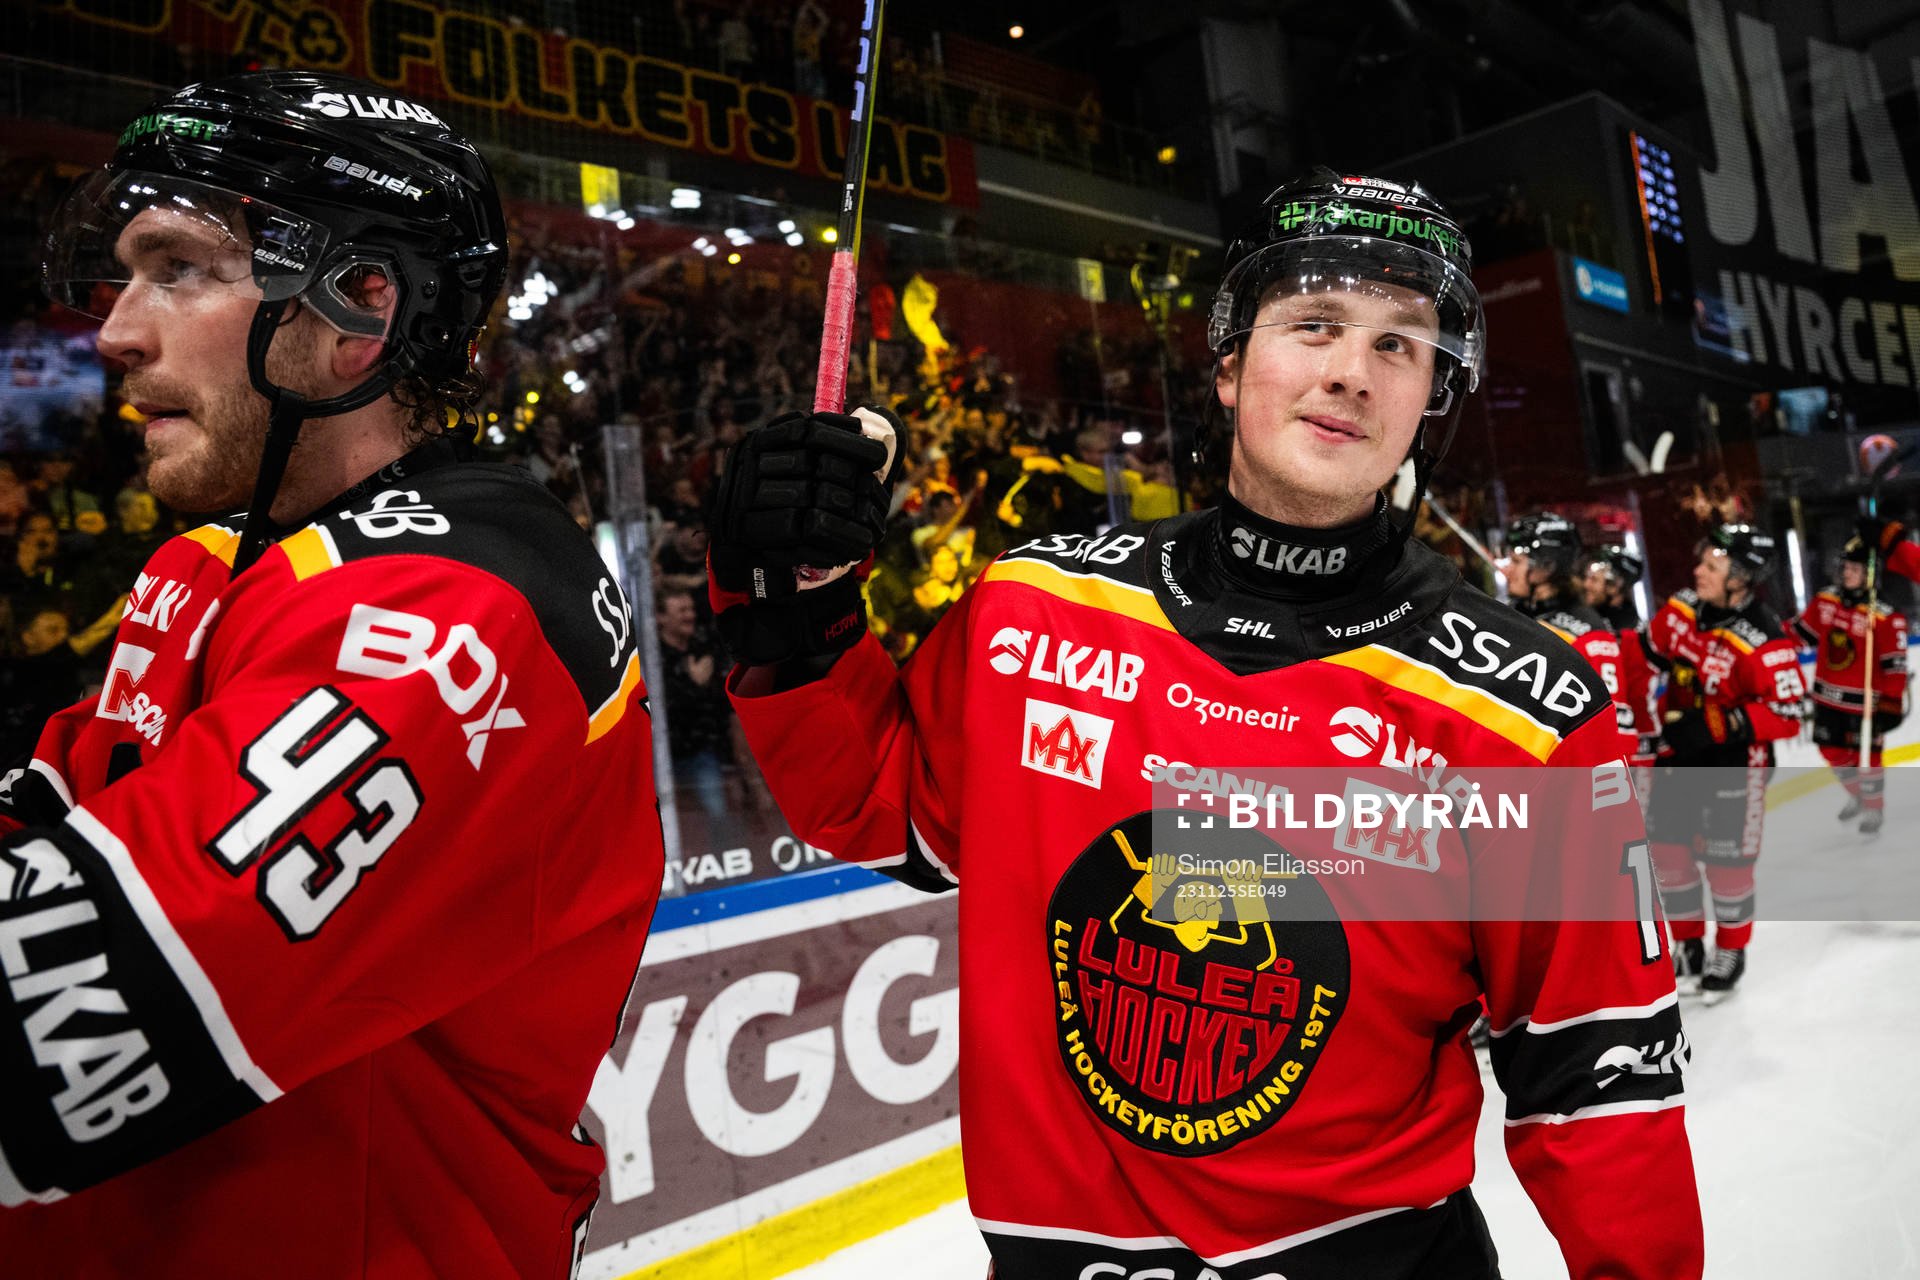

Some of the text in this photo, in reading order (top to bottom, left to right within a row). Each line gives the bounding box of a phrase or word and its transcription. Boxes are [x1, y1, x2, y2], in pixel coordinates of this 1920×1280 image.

[347, 94, 441, 126] LKAB
[364, 2, 798, 169] FOLKETS
[1690, 0, 1920, 281] JIA
[324, 155, 423, 202] BAUER
[1348, 187, 1419, 206] BAUER
[254, 248, 305, 271] BAUER
[1256, 539, 1347, 575] LKAB
[1224, 617, 1276, 639] SHL
[1345, 602, 1413, 637] BAUER
[1028, 635, 1145, 702] LKAB
[1428, 611, 1592, 718] SSAB
[1167, 682, 1300, 732] Ozoneair
[1028, 713, 1100, 781] MAX
[206, 685, 425, 943] 43
[1078, 917, 1301, 1020] LULEÅ
[0, 899, 171, 1143] LKAB
[1053, 919, 1337, 1146] LULEÅ HOCKEYFÖRENING 1977
[1077, 969, 1292, 1105] HOCKEY
